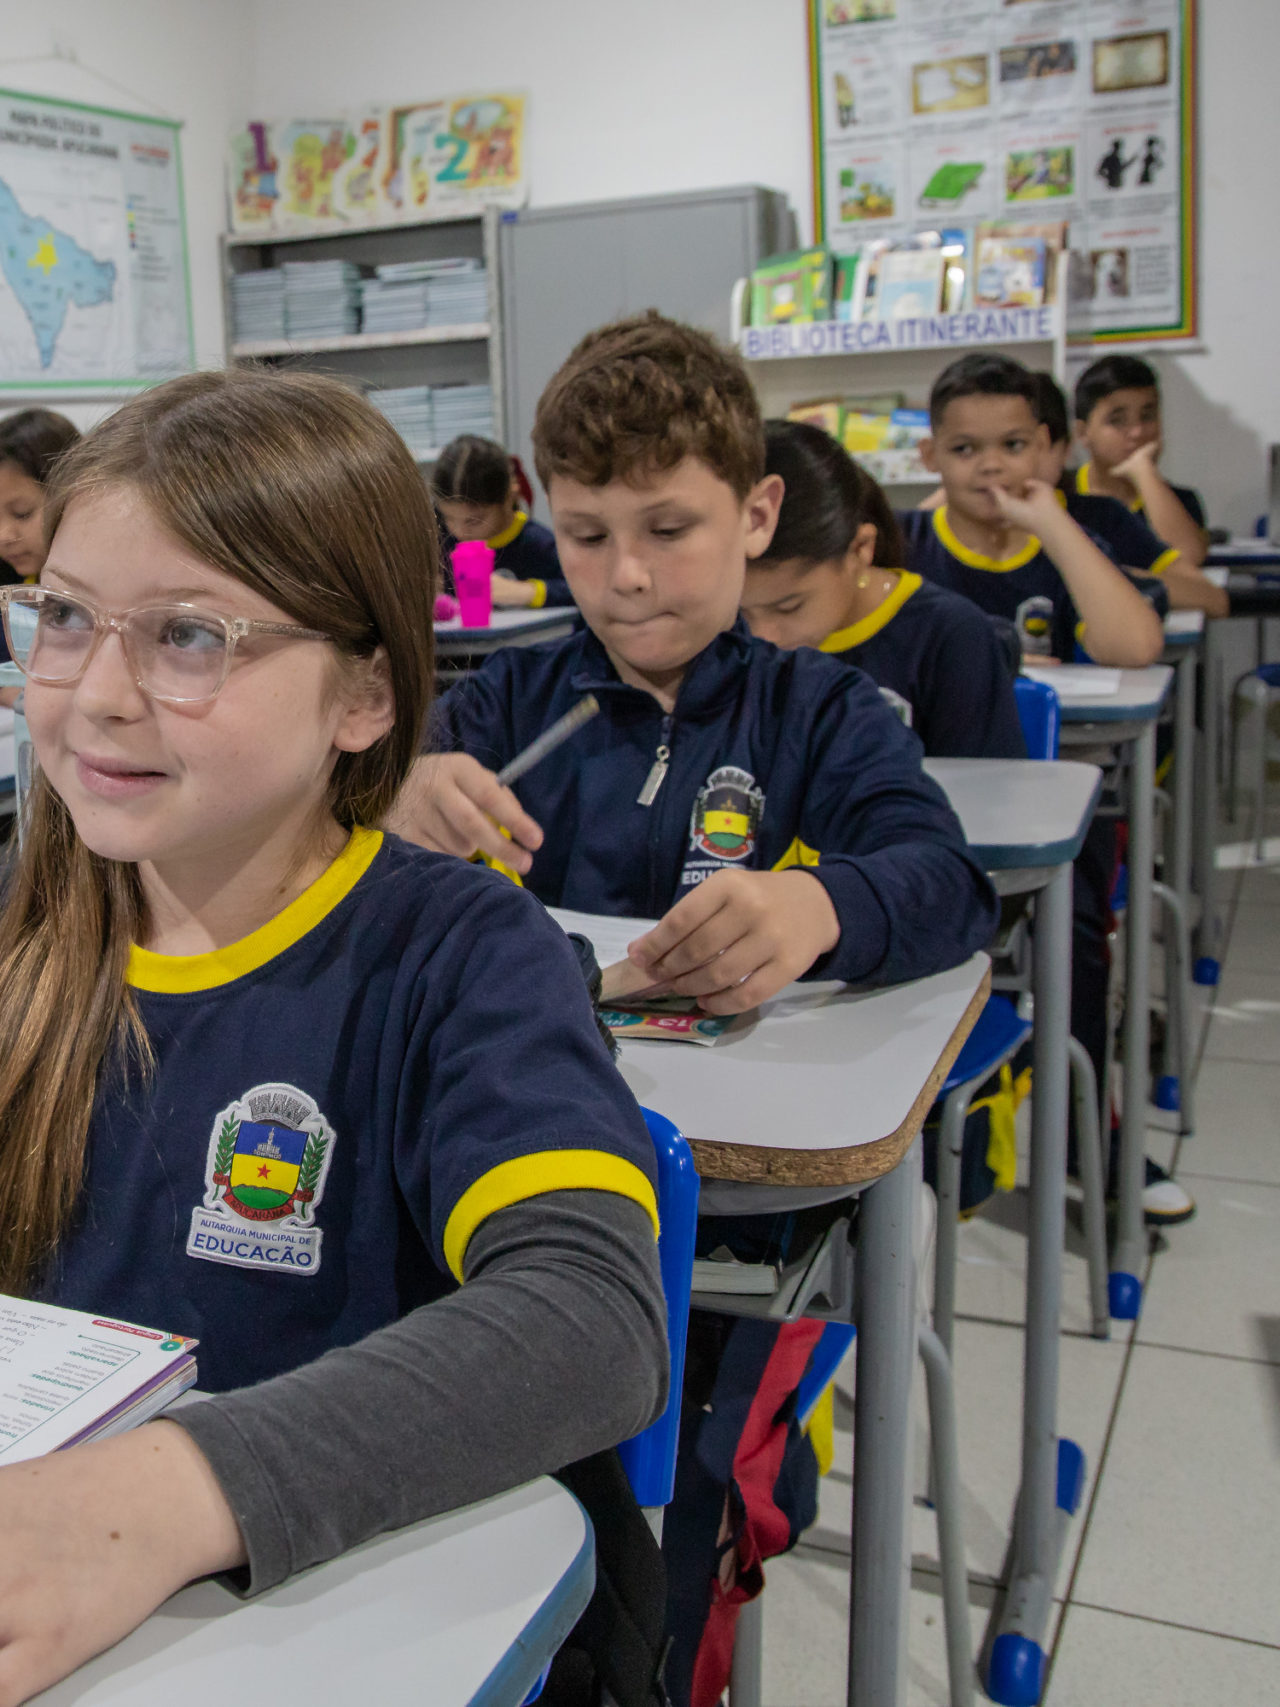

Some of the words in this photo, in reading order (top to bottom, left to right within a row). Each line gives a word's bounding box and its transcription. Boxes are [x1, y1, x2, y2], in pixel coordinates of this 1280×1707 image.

[747, 320, 891, 357] BIBLIOTECA
[896, 307, 1052, 346] ITINERANTE
[200, 1219, 247, 1237] AUTARQUIA
[248, 1230, 297, 1244] MUNICIPAL
[299, 1236, 312, 1245] DE
